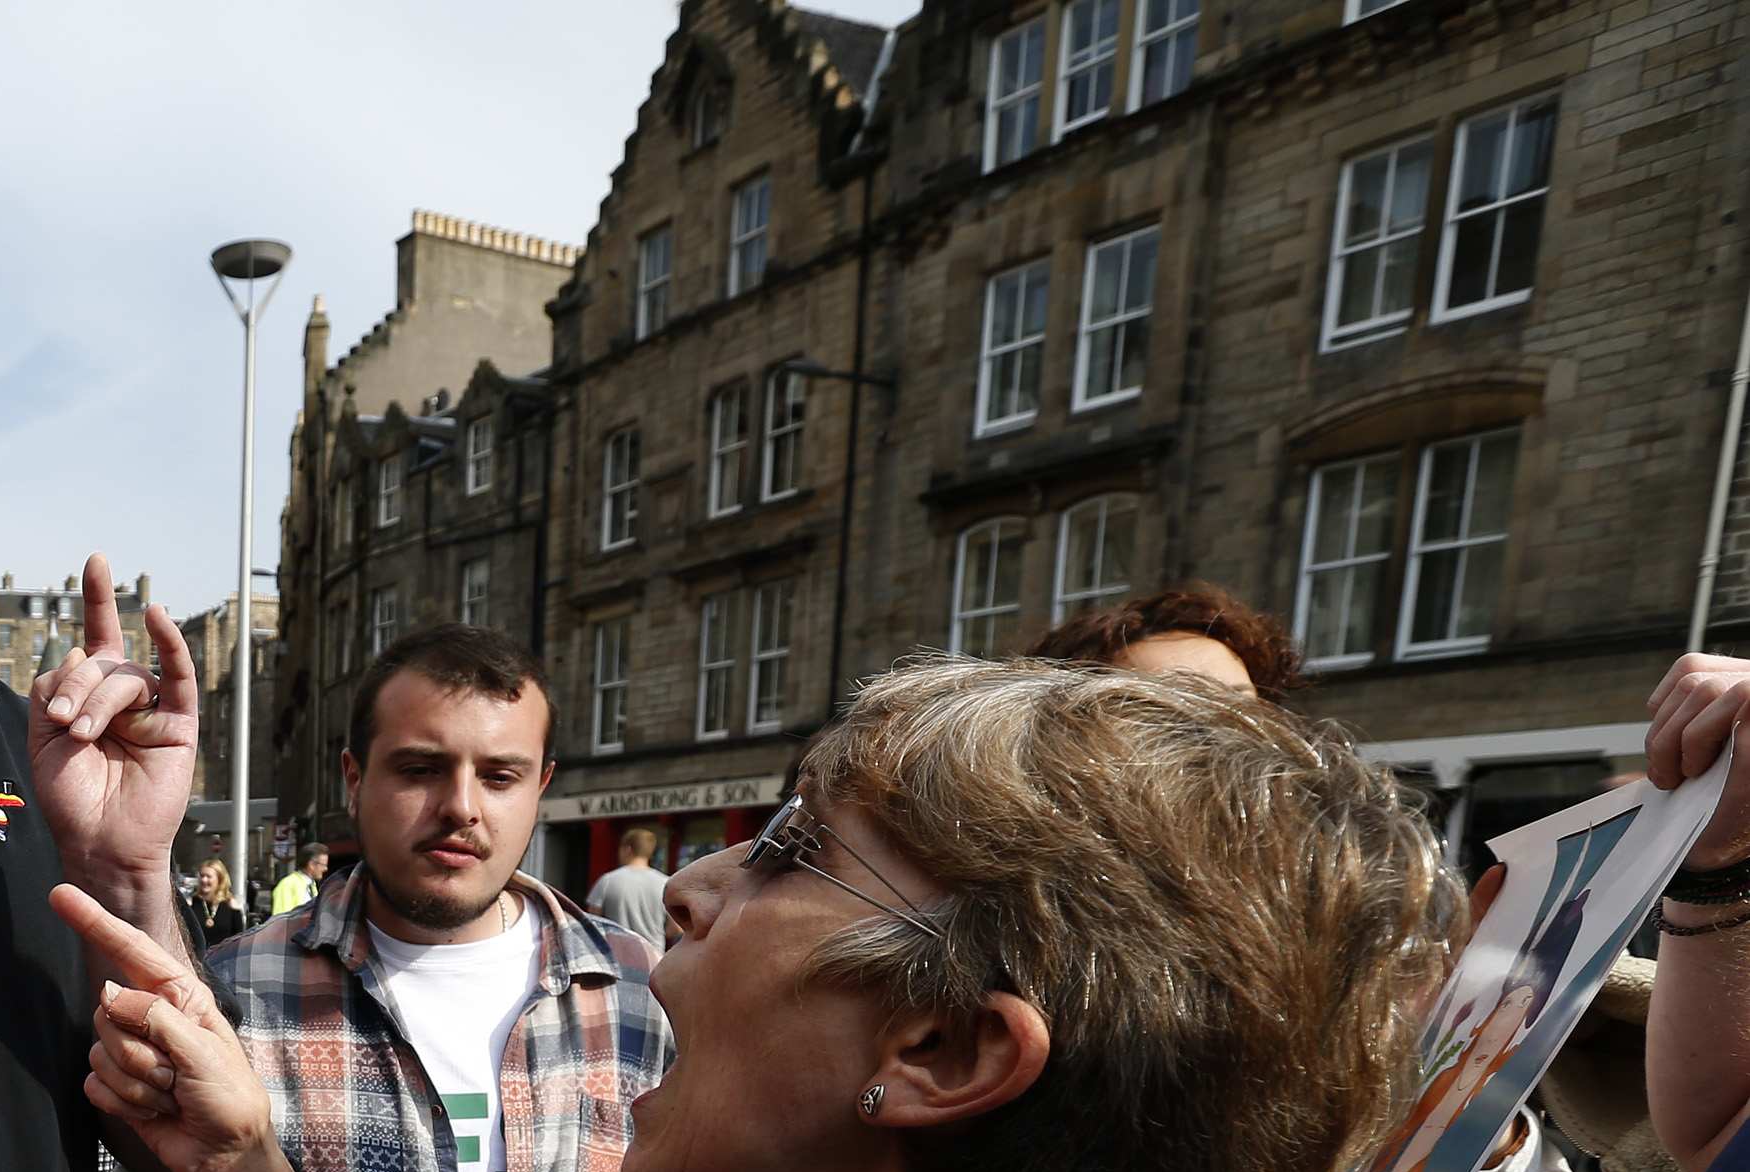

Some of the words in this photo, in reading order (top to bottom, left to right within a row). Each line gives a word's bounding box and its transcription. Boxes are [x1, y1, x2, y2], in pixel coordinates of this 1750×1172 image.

[598, 787, 698, 813] ARMSTRONG
[705, 785, 716, 806] &
[722, 780, 762, 805] SON
